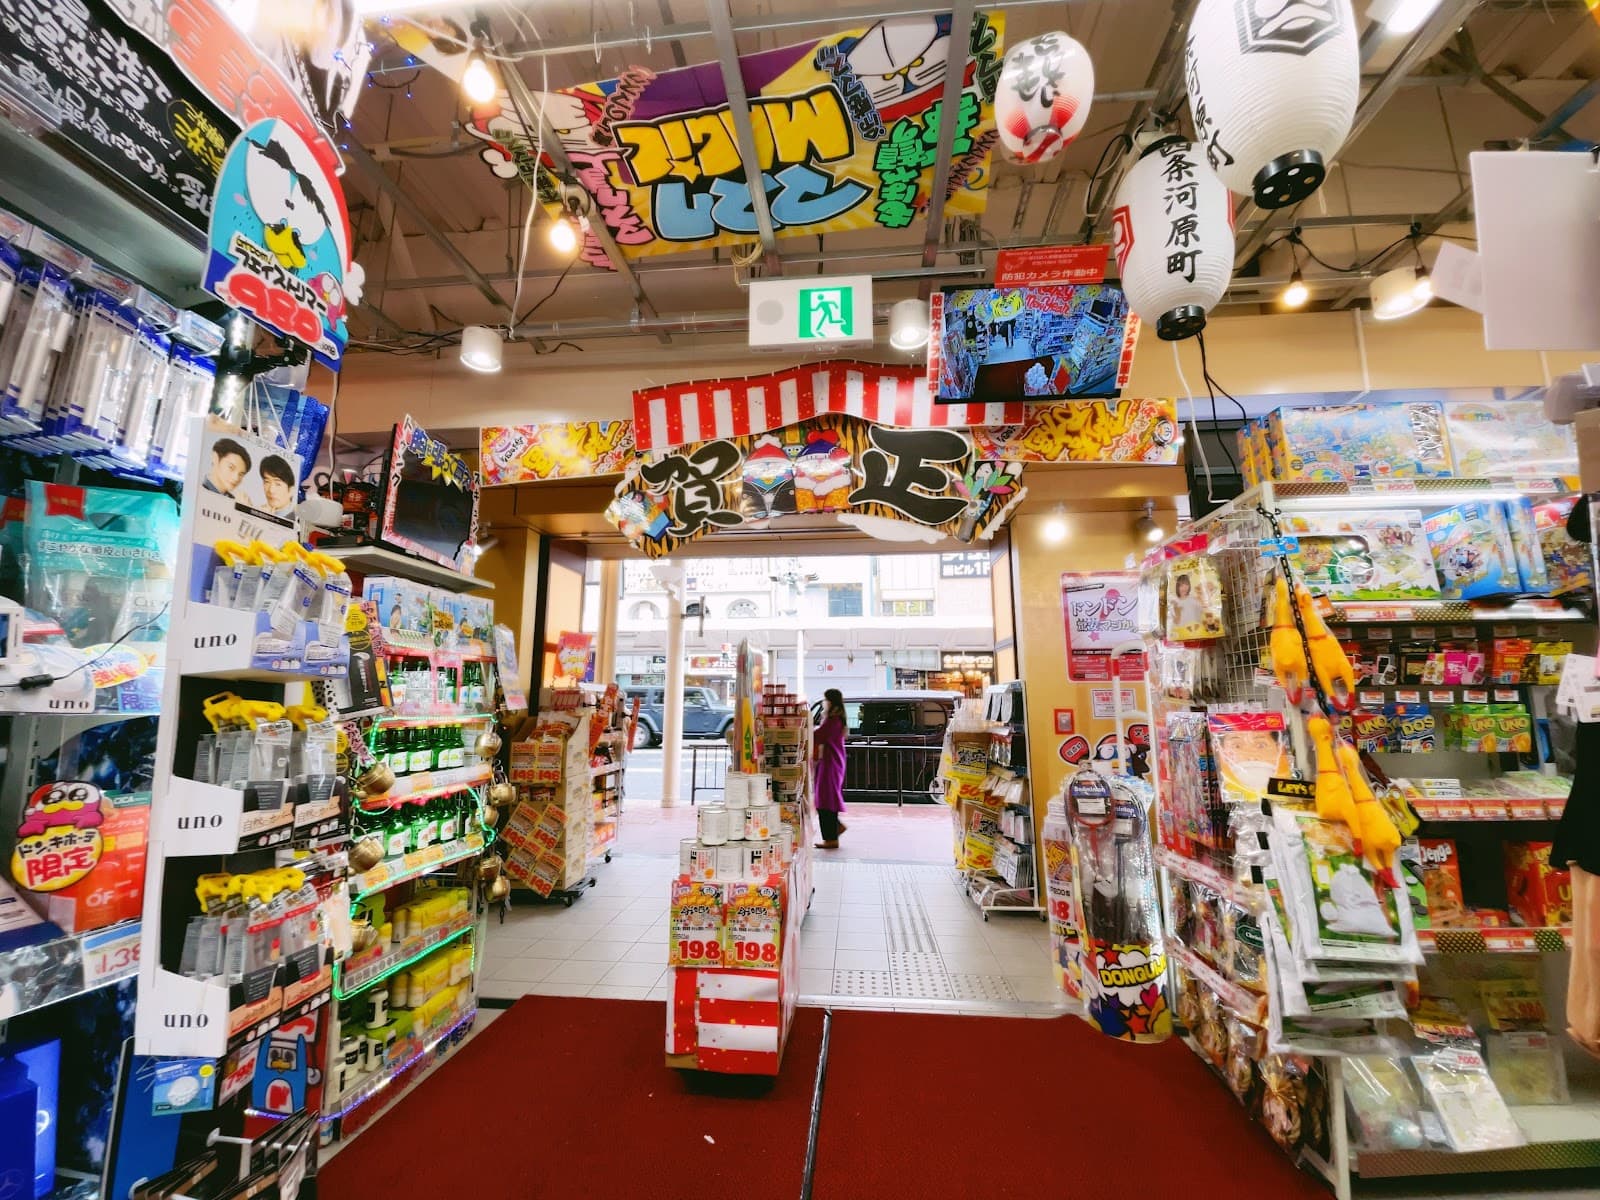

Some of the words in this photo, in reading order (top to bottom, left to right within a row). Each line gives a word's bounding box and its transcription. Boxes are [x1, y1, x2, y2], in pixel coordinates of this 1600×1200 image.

[650, 161, 874, 241] マスク
[1001, 268, 1099, 281] 防犯カメラ作動中
[229, 273, 322, 343] 980
[202, 507, 231, 524] uno
[193, 632, 237, 649] uno
[49, 699, 90, 710] uno
[1401, 715, 1435, 735] DOS
[178, 814, 223, 830] uno
[1421, 842, 1453, 863] Jenga
[26, 846, 96, 887] 限定
[678, 940, 721, 960] 198
[734, 941, 777, 963] 198
[164, 1013, 209, 1029] uno
